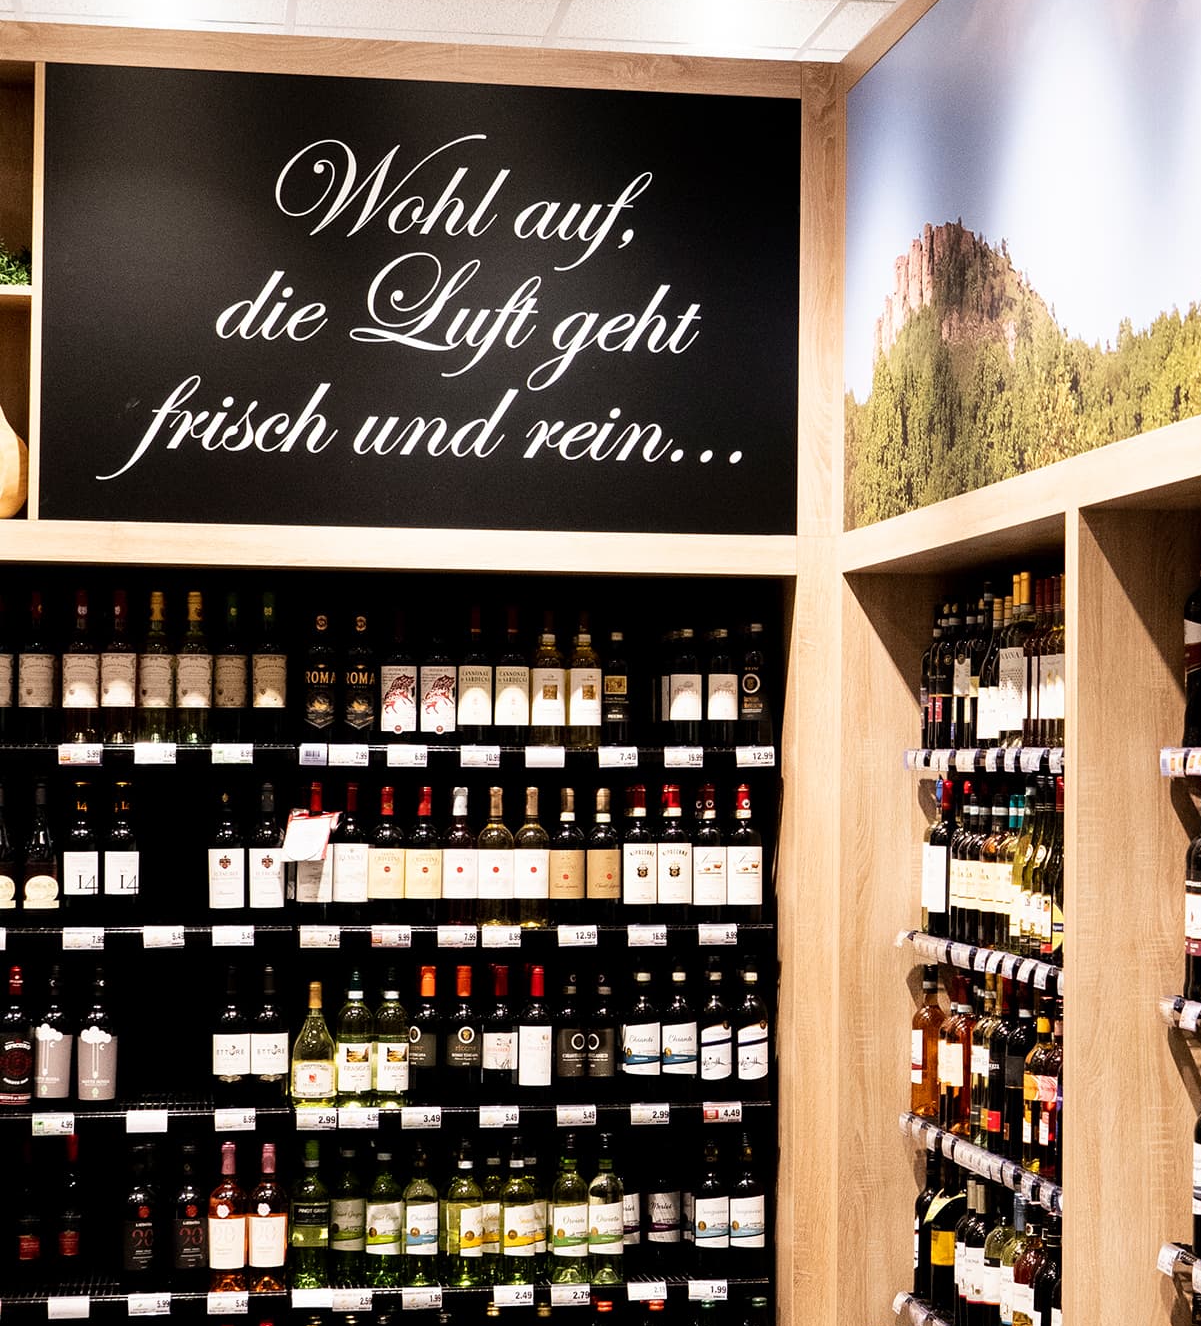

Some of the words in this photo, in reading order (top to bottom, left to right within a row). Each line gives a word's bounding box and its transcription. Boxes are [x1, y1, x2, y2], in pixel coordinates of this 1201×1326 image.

[274, 134, 511, 238] Wohl
[514, 172, 653, 272] auf,
[215, 270, 328, 340] die
[350, 252, 538, 379] Luft
[526, 284, 700, 392] geht
[95, 375, 338, 480] frisch
[353, 388, 517, 458] und
[524, 406, 744, 465] rein...
[620, 752, 637, 761] 7.49
[753, 752, 774, 761] 12.99
[575, 931, 596, 940] 12.99
[652, 1110, 670, 1119] 2.99
[723, 1108, 741, 1118] 4.49
[318, 1115, 336, 1124] 2.99
[423, 1114, 441, 1123] 3.49
[650, 1201, 672, 1211] Merlot
[710, 1285, 727, 1294] 1.99
[515, 1291, 532, 1300] 2.49
[572, 1290, 590, 1300] 2.79
